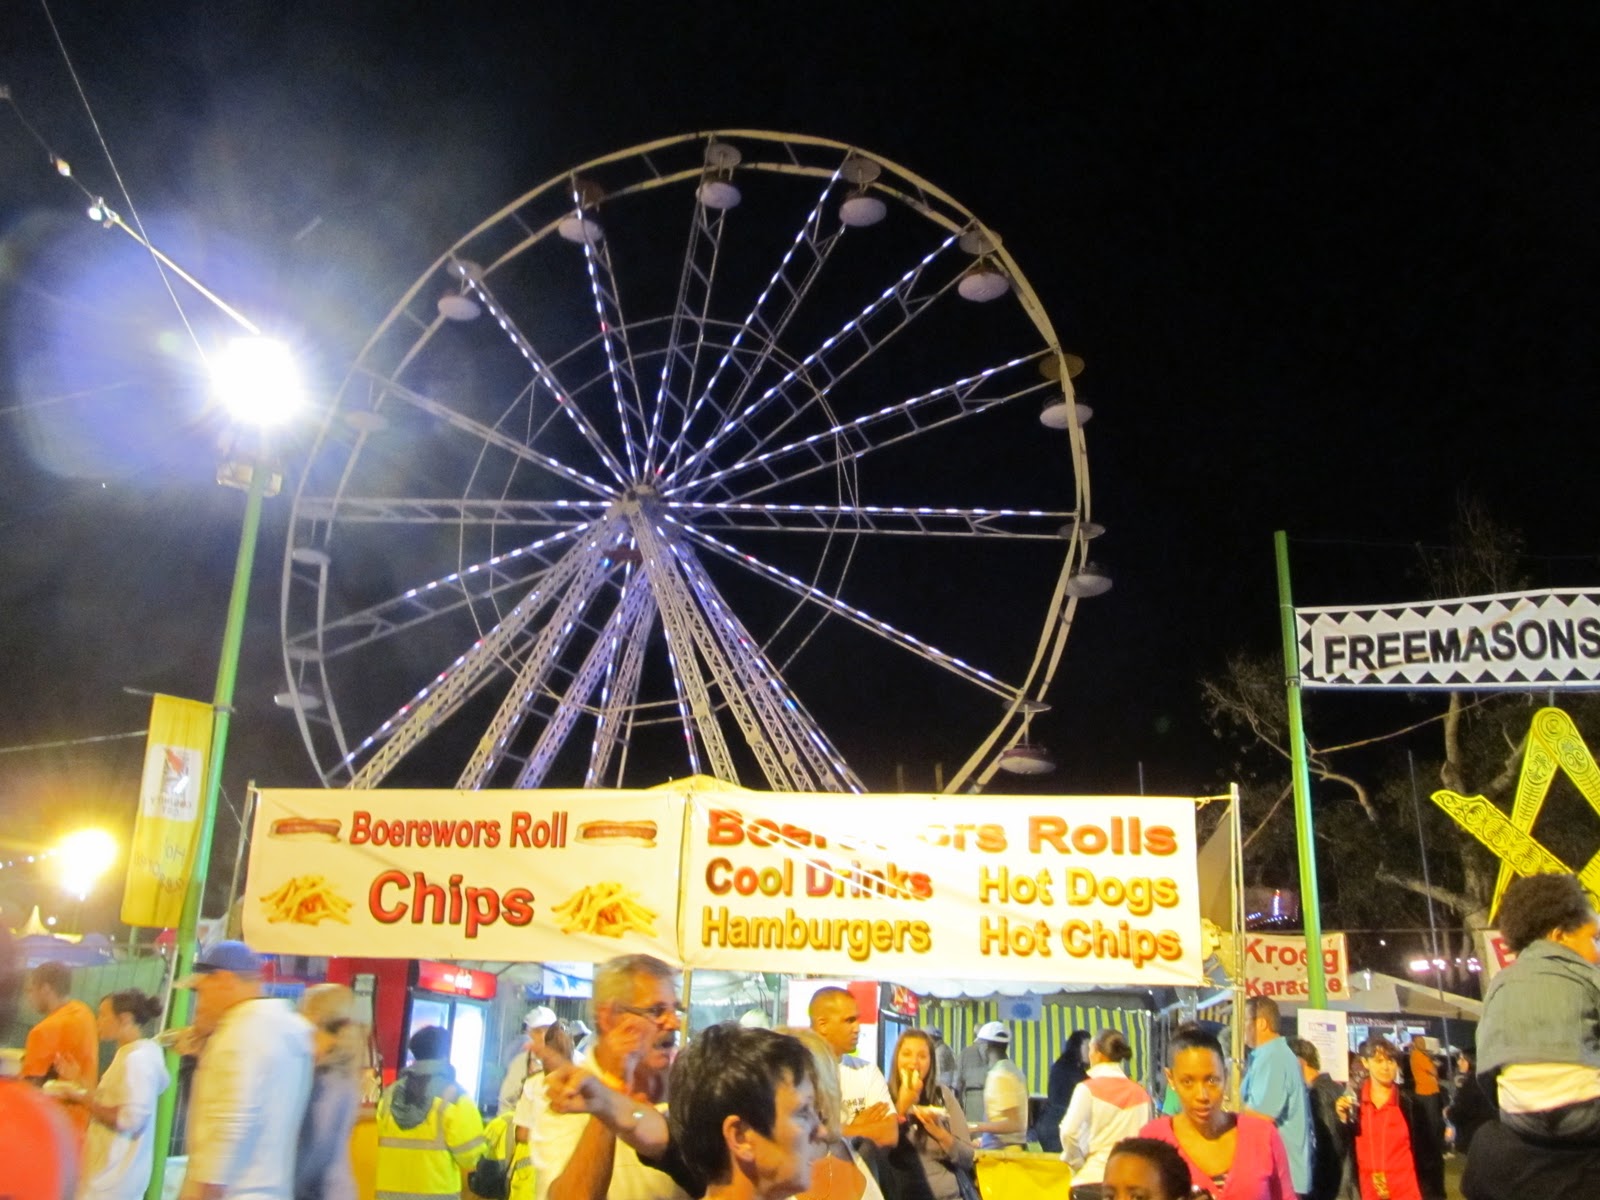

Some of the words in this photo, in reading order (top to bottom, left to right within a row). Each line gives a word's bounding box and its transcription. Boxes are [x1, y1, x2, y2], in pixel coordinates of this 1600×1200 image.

[1324, 617, 1600, 675] FREEMASONS
[349, 810, 501, 848] Boerewors
[509, 811, 568, 848] Roll
[707, 808, 1008, 853] Boers
[1027, 815, 1178, 856] Rolls
[369, 869, 535, 939] Chips
[705, 857, 793, 897] Cool
[806, 859, 933, 901] Drinks
[979, 865, 1054, 906] Hot
[1065, 866, 1180, 917] Dogs
[701, 905, 932, 961] Hamburgers
[979, 916, 1052, 957] Hot
[1061, 918, 1183, 969] Chips
[1244, 977, 1343, 997] Karaoe
